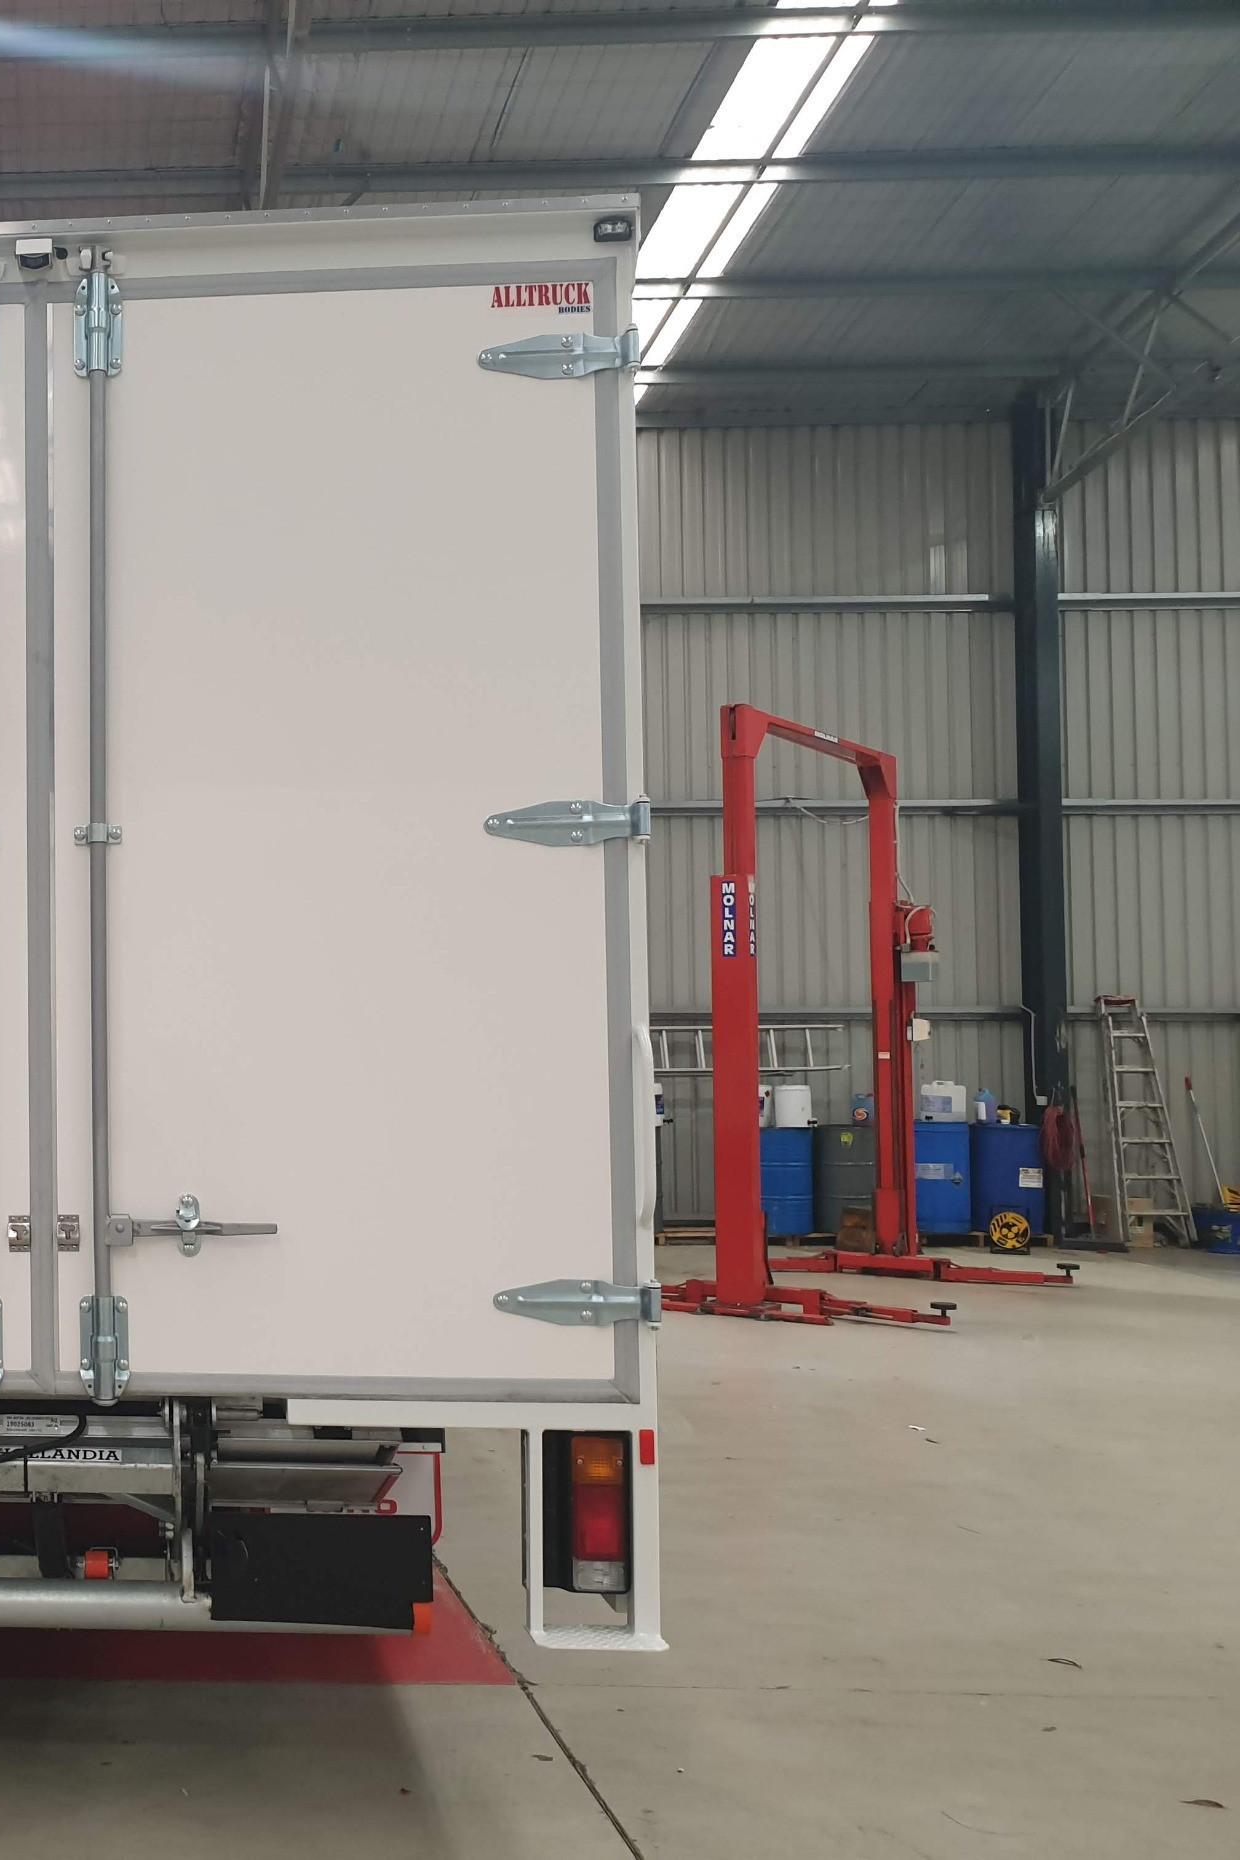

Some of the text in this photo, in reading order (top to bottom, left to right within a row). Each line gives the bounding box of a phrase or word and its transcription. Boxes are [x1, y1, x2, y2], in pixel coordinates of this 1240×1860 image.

[490, 282, 591, 308] ALLTRUCK
[558, 305, 591, 314] BODIES
[722, 882, 735, 955] MOLNAR
